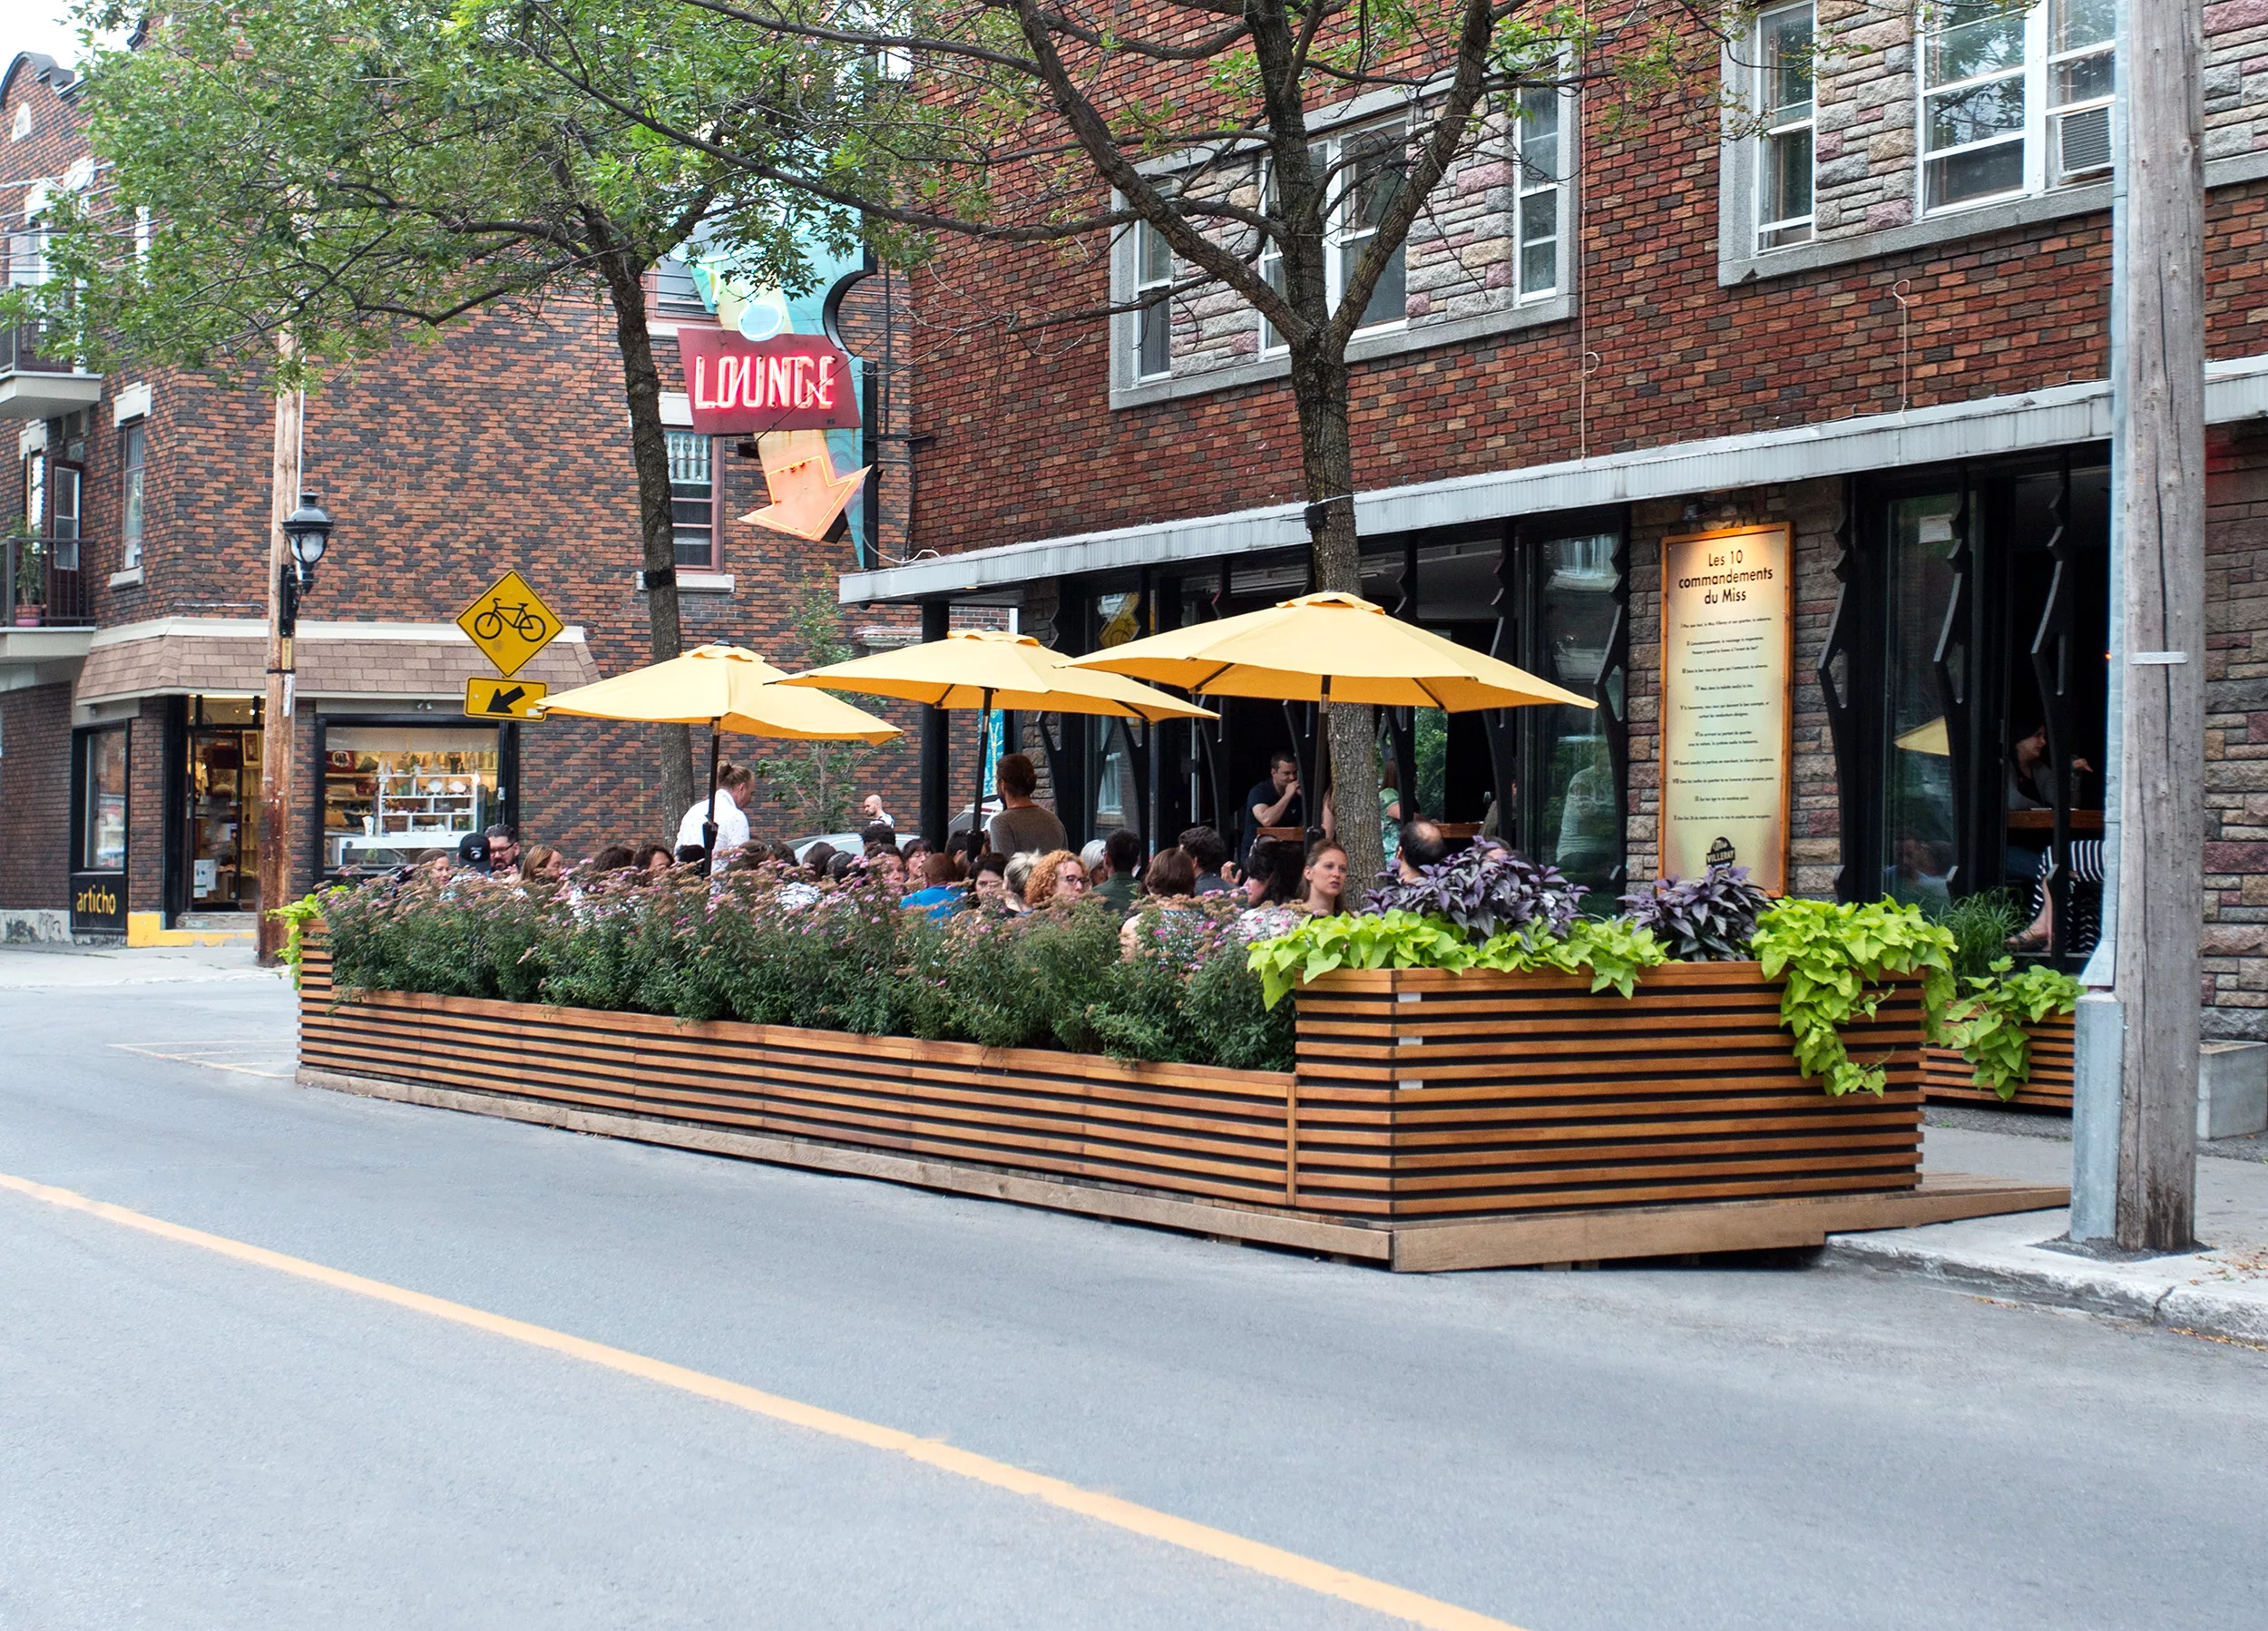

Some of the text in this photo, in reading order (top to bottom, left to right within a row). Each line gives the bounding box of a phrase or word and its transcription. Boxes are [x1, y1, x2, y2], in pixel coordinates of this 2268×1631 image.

[694, 355, 835, 410] LOUNGE
[1708, 549, 1744, 567] Les 10
[1678, 567, 1774, 589] commandements
[1704, 587, 1746, 605] du Miss
[76, 884, 117, 915] articho
